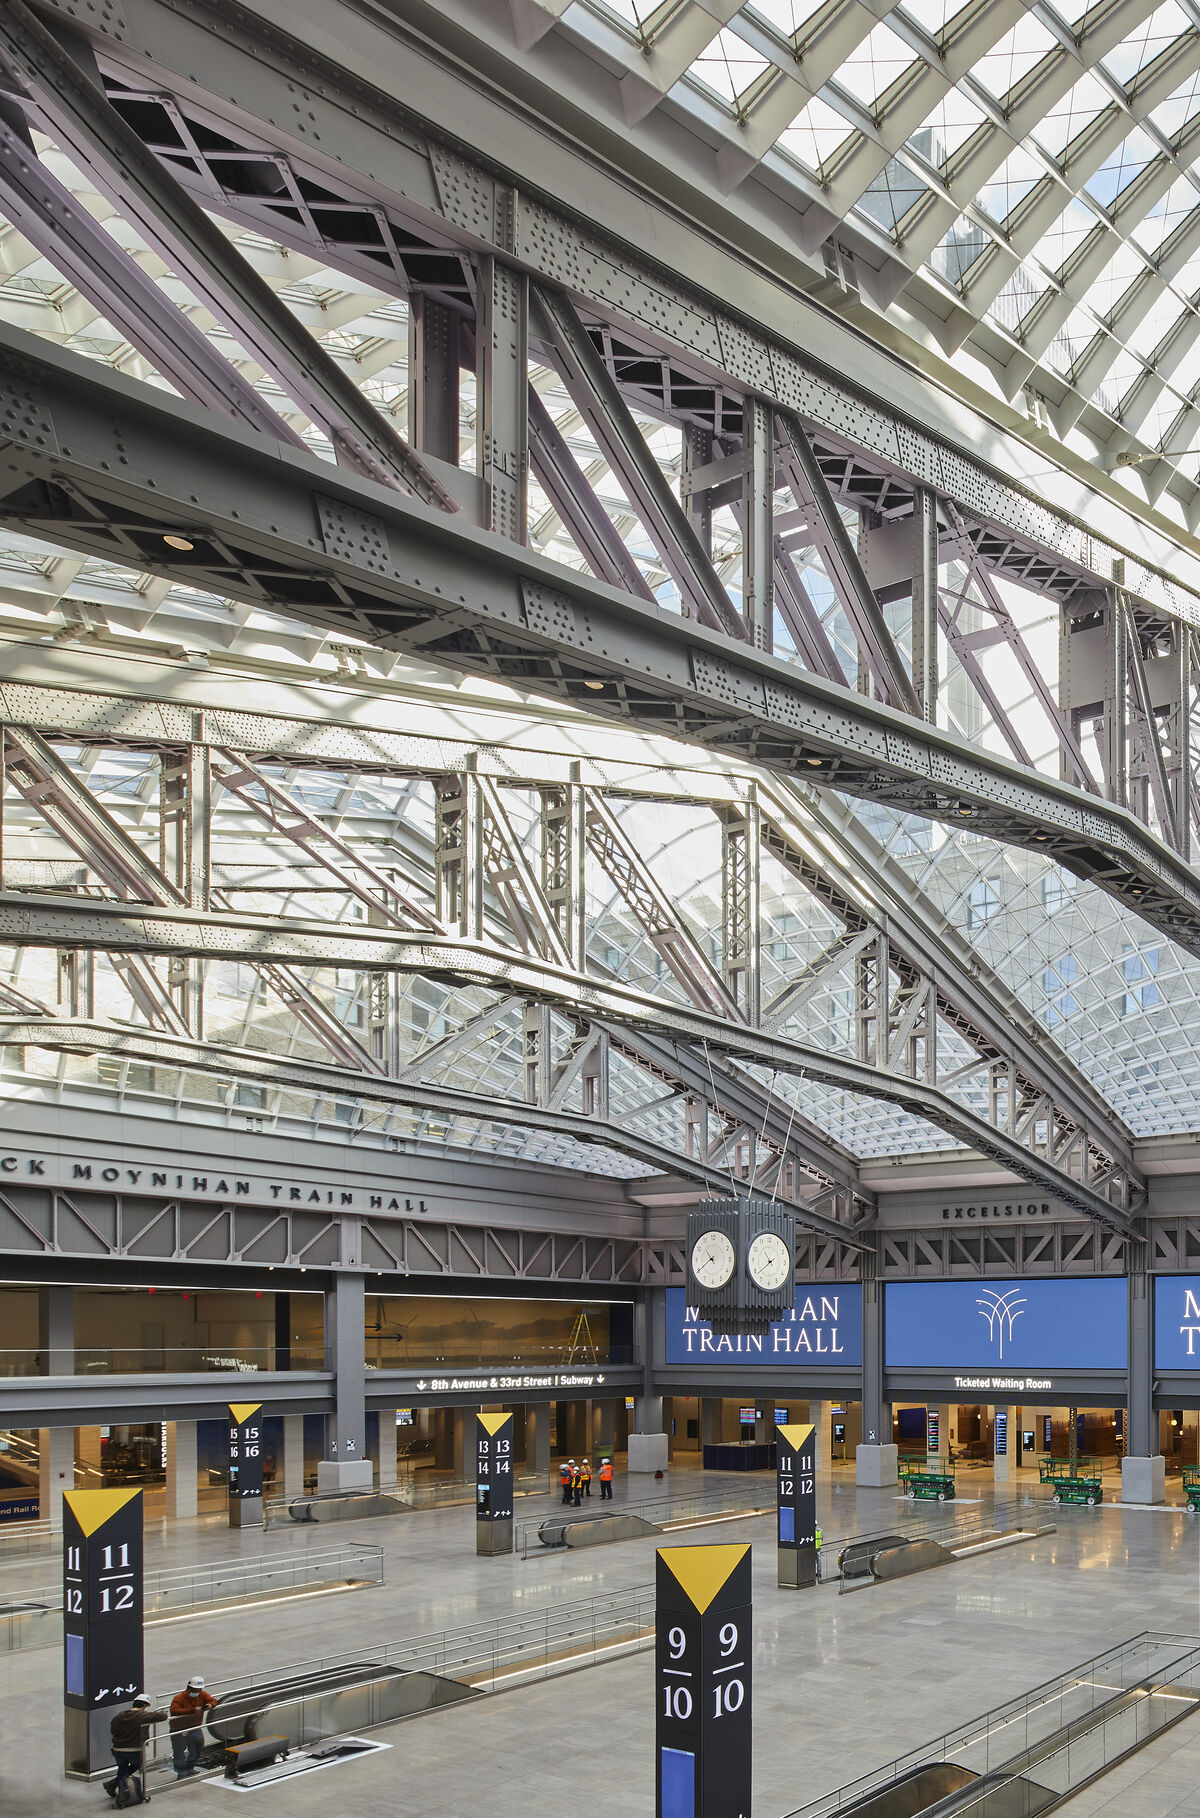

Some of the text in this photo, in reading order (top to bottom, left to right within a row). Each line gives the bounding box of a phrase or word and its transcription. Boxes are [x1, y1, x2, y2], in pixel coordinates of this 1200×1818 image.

[1, 1157, 428, 1213] CK MOYNIHAN TRAIN HALL
[942, 1204, 1050, 1219] EXCELSIOR
[682, 1328, 844, 1352] TRAIN HALL
[431, 1379, 448, 1390] 8th
[450, 1378, 488, 1390] Avenue
[490, 1378, 498, 1388] &
[500, 1377, 522, 1388] 33rd
[523, 1376, 552, 1387] Street
[560, 1374, 594, 1386] Subway
[954, 1377, 1052, 1390] Ticketed Waiting Room
[230, 1428, 238, 1439] 15
[245, 1428, 259, 1439] 15
[230, 1446, 238, 1458] 16
[245, 1446, 260, 1458] 16
[479, 1440, 489, 1453] 13
[496, 1440, 510, 1453] 13
[478, 1462, 489, 1474] 14
[496, 1461, 510, 1474] 14
[781, 1457, 791, 1471] 11
[801, 1455, 811, 1470] 11
[780, 1481, 793, 1495] 12
[801, 1480, 813, 1494] 12
[67, 1546, 80, 1571] 11
[101, 1543, 131, 1570] 11
[67, 1588, 82, 1614] 12
[99, 1585, 134, 1613] 12
[668, 1626, 686, 1659] 9
[719, 1622, 738, 1657] 9
[663, 1685, 693, 1720] 10
[712, 1679, 744, 1719] 10
